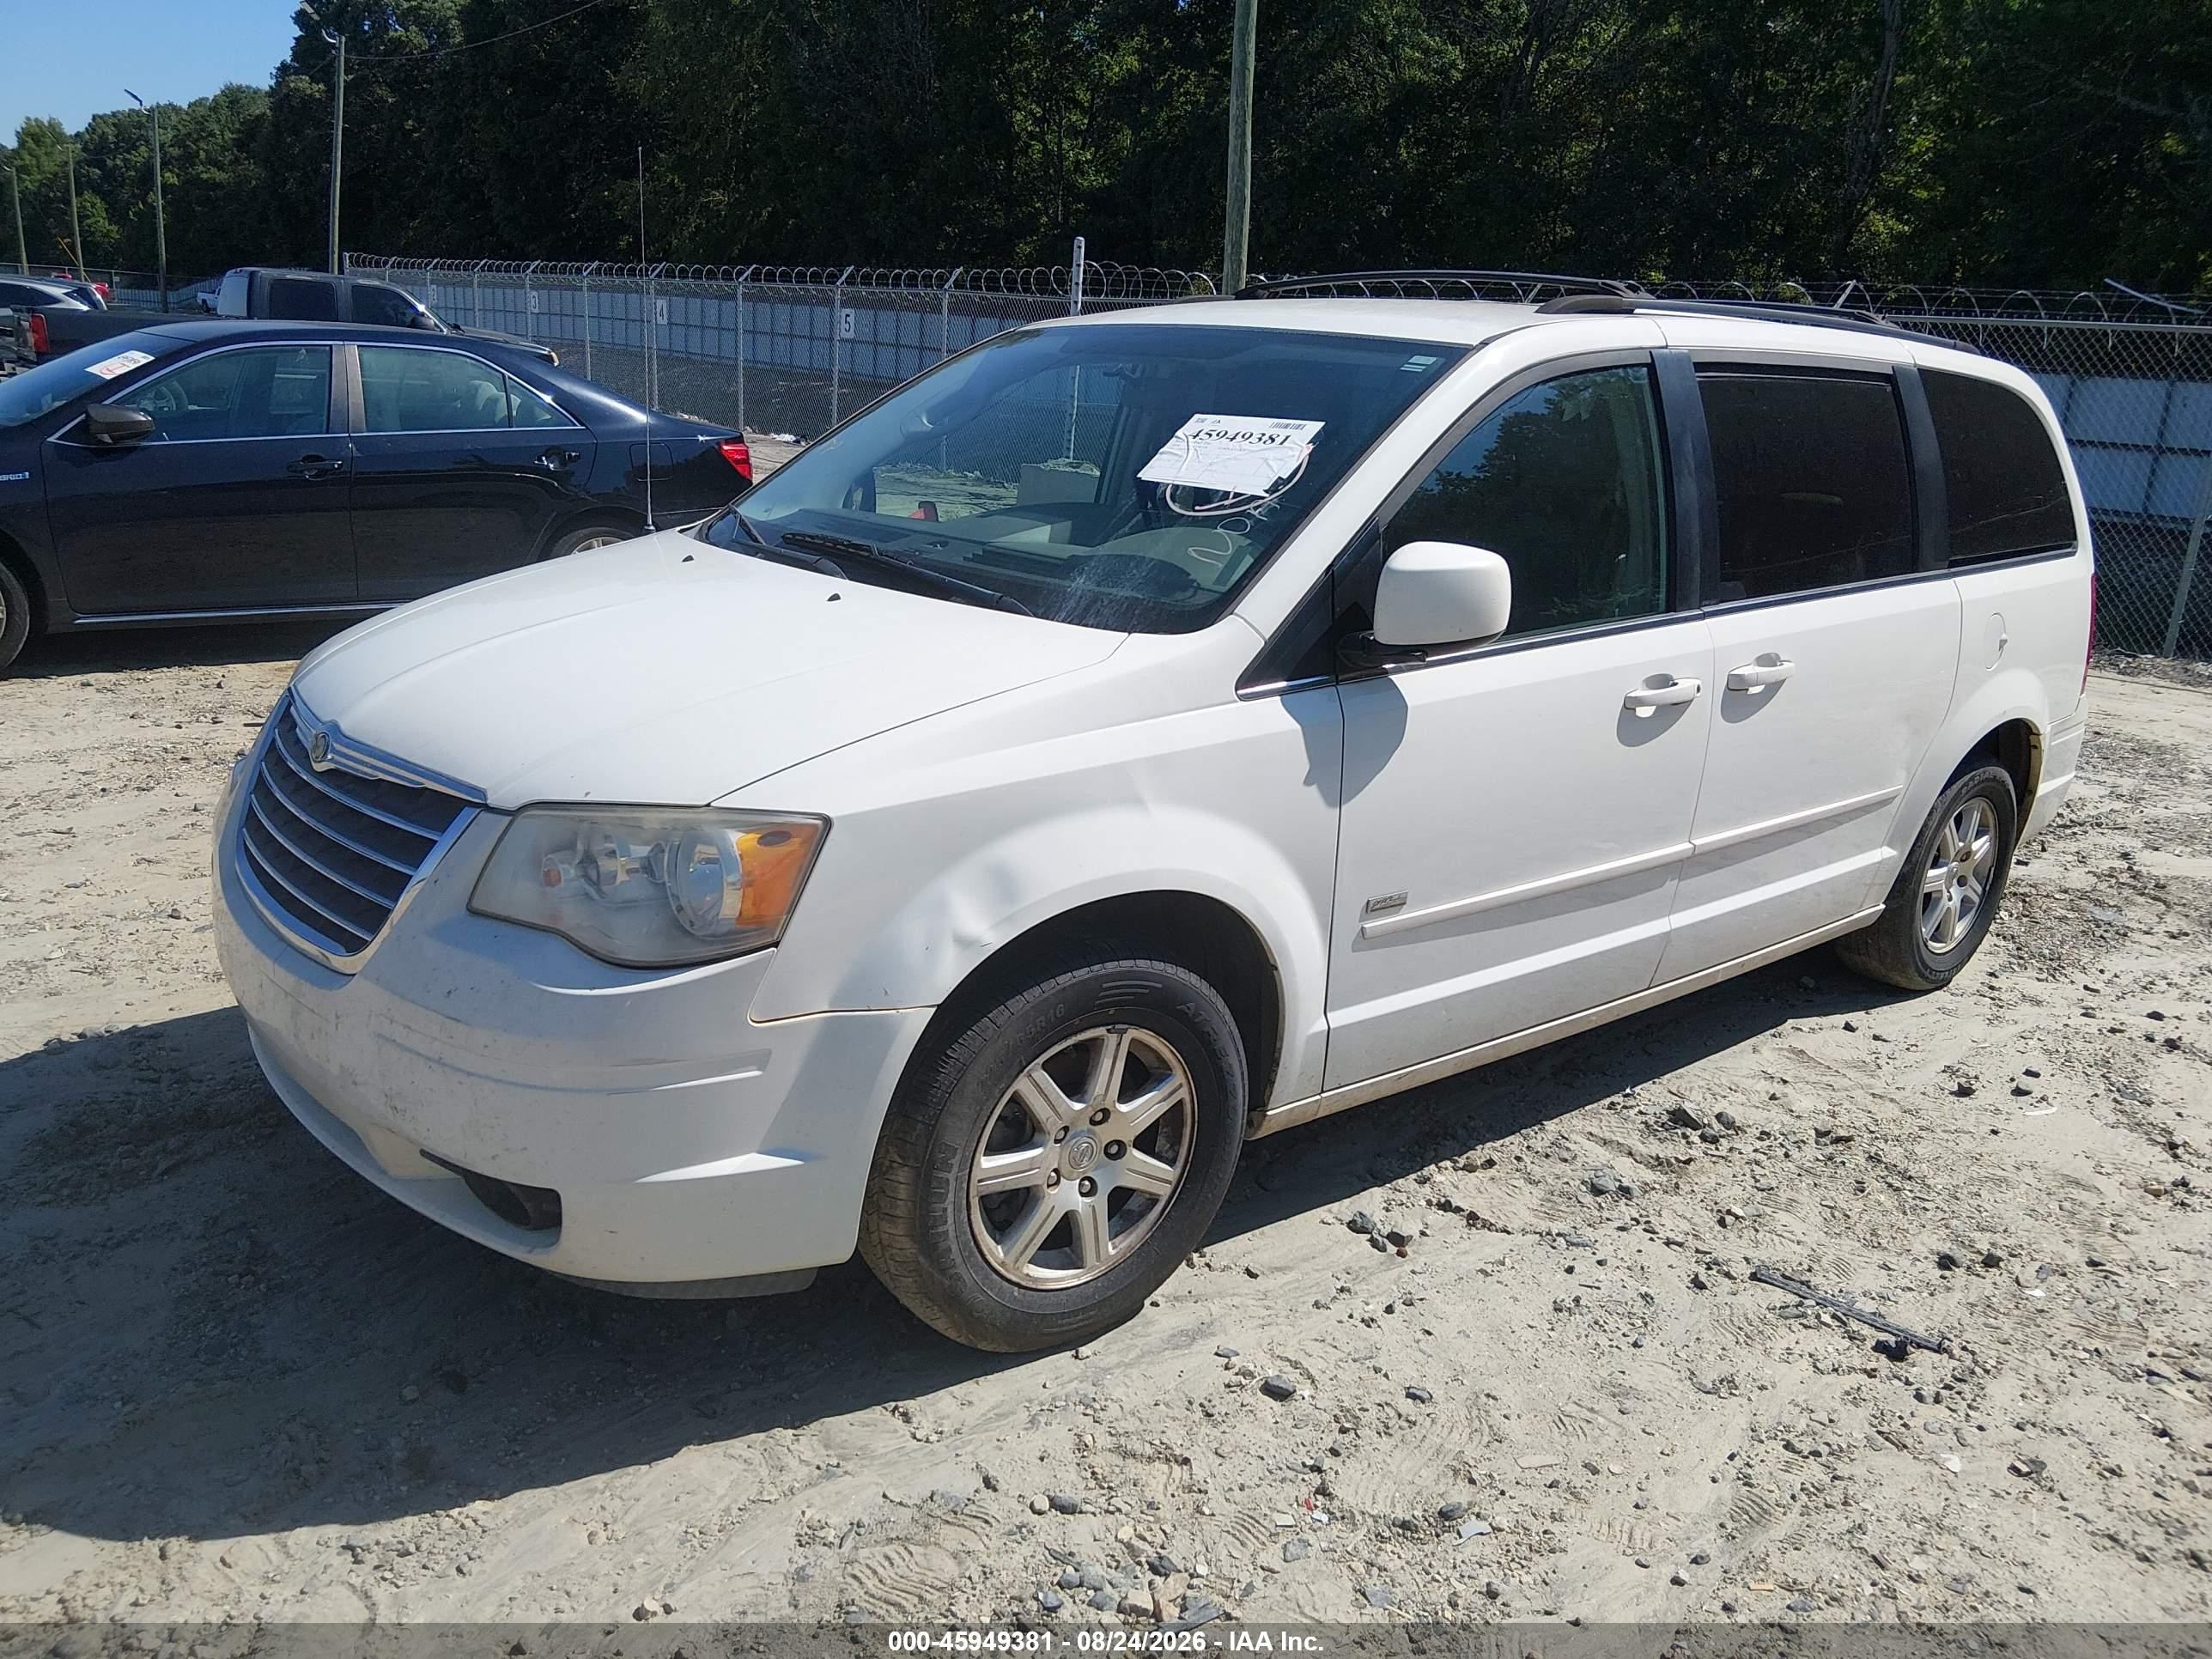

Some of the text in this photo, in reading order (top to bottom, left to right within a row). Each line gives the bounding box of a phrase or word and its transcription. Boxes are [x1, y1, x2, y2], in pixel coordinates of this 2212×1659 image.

[657, 302, 665, 321] 4
[844, 313, 852, 333] 5
[1188, 428, 1292, 446] 45949381
